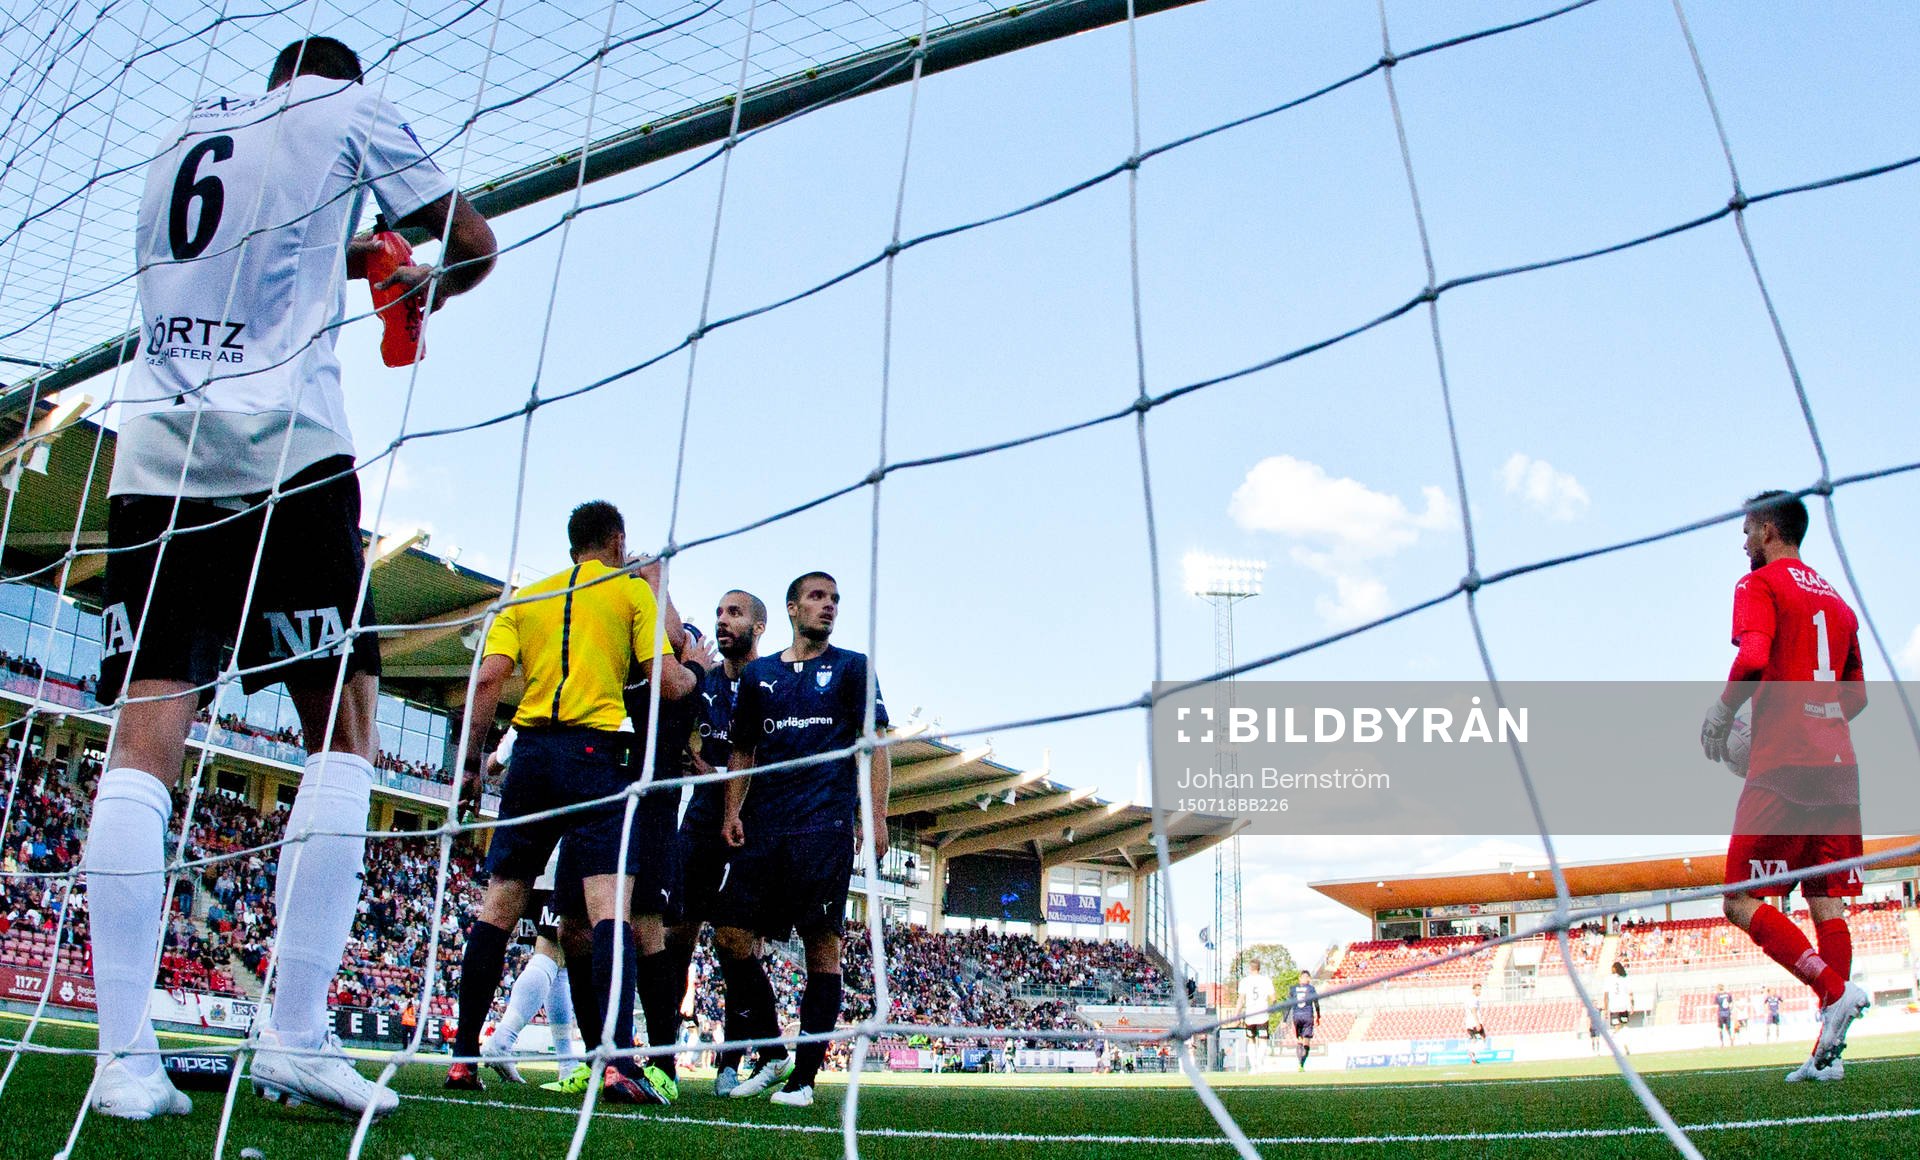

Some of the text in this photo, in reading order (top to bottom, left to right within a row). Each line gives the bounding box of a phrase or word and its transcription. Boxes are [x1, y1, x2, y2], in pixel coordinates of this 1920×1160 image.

[170, 135, 234, 260] 6
[217, 350, 244, 363] AB
[102, 601, 139, 661] A
[263, 606, 354, 659] NA
[1813, 609, 1835, 681] 1
[1749, 859, 1789, 880] NA
[1049, 893, 1096, 908] NA NA
[1105, 901, 1131, 924] MAX
[15, 974, 42, 990] 1177
[1252, 986, 1260, 1001] 5
[350, 1012, 363, 1034] E
[376, 1013, 389, 1036] E
[427, 1019, 440, 1039] E
